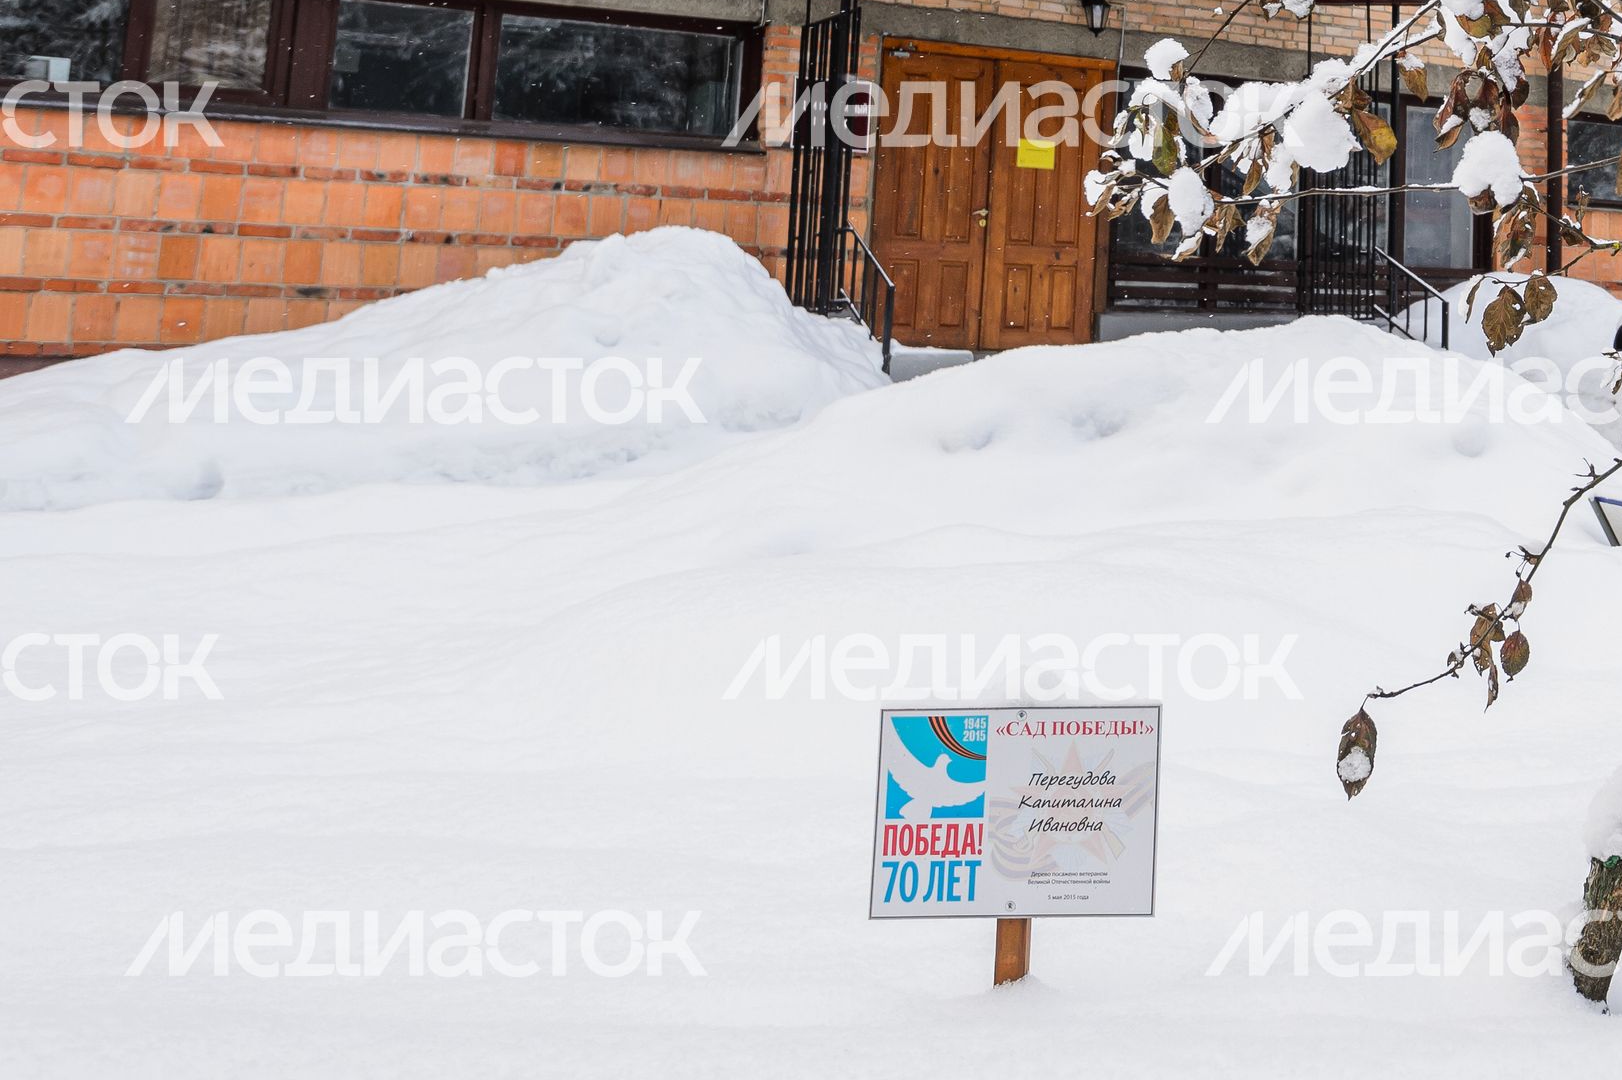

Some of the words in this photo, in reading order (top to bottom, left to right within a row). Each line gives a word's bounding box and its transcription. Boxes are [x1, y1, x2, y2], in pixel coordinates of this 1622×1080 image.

[964, 718, 986, 730] 1945
[996, 720, 1046, 738] «САД
[1052, 719, 1154, 737] ПОБЕДЫ!»
[963, 730, 986, 742] 2015
[1027, 768, 1116, 790] Перегудова
[1018, 794, 1122, 809] Капиталина
[1028, 817, 1102, 833] Ивановна
[882, 823, 983, 858] ПОБЕДА!
[882, 861, 919, 903] 70
[922, 860, 981, 903] ЛЕТ
